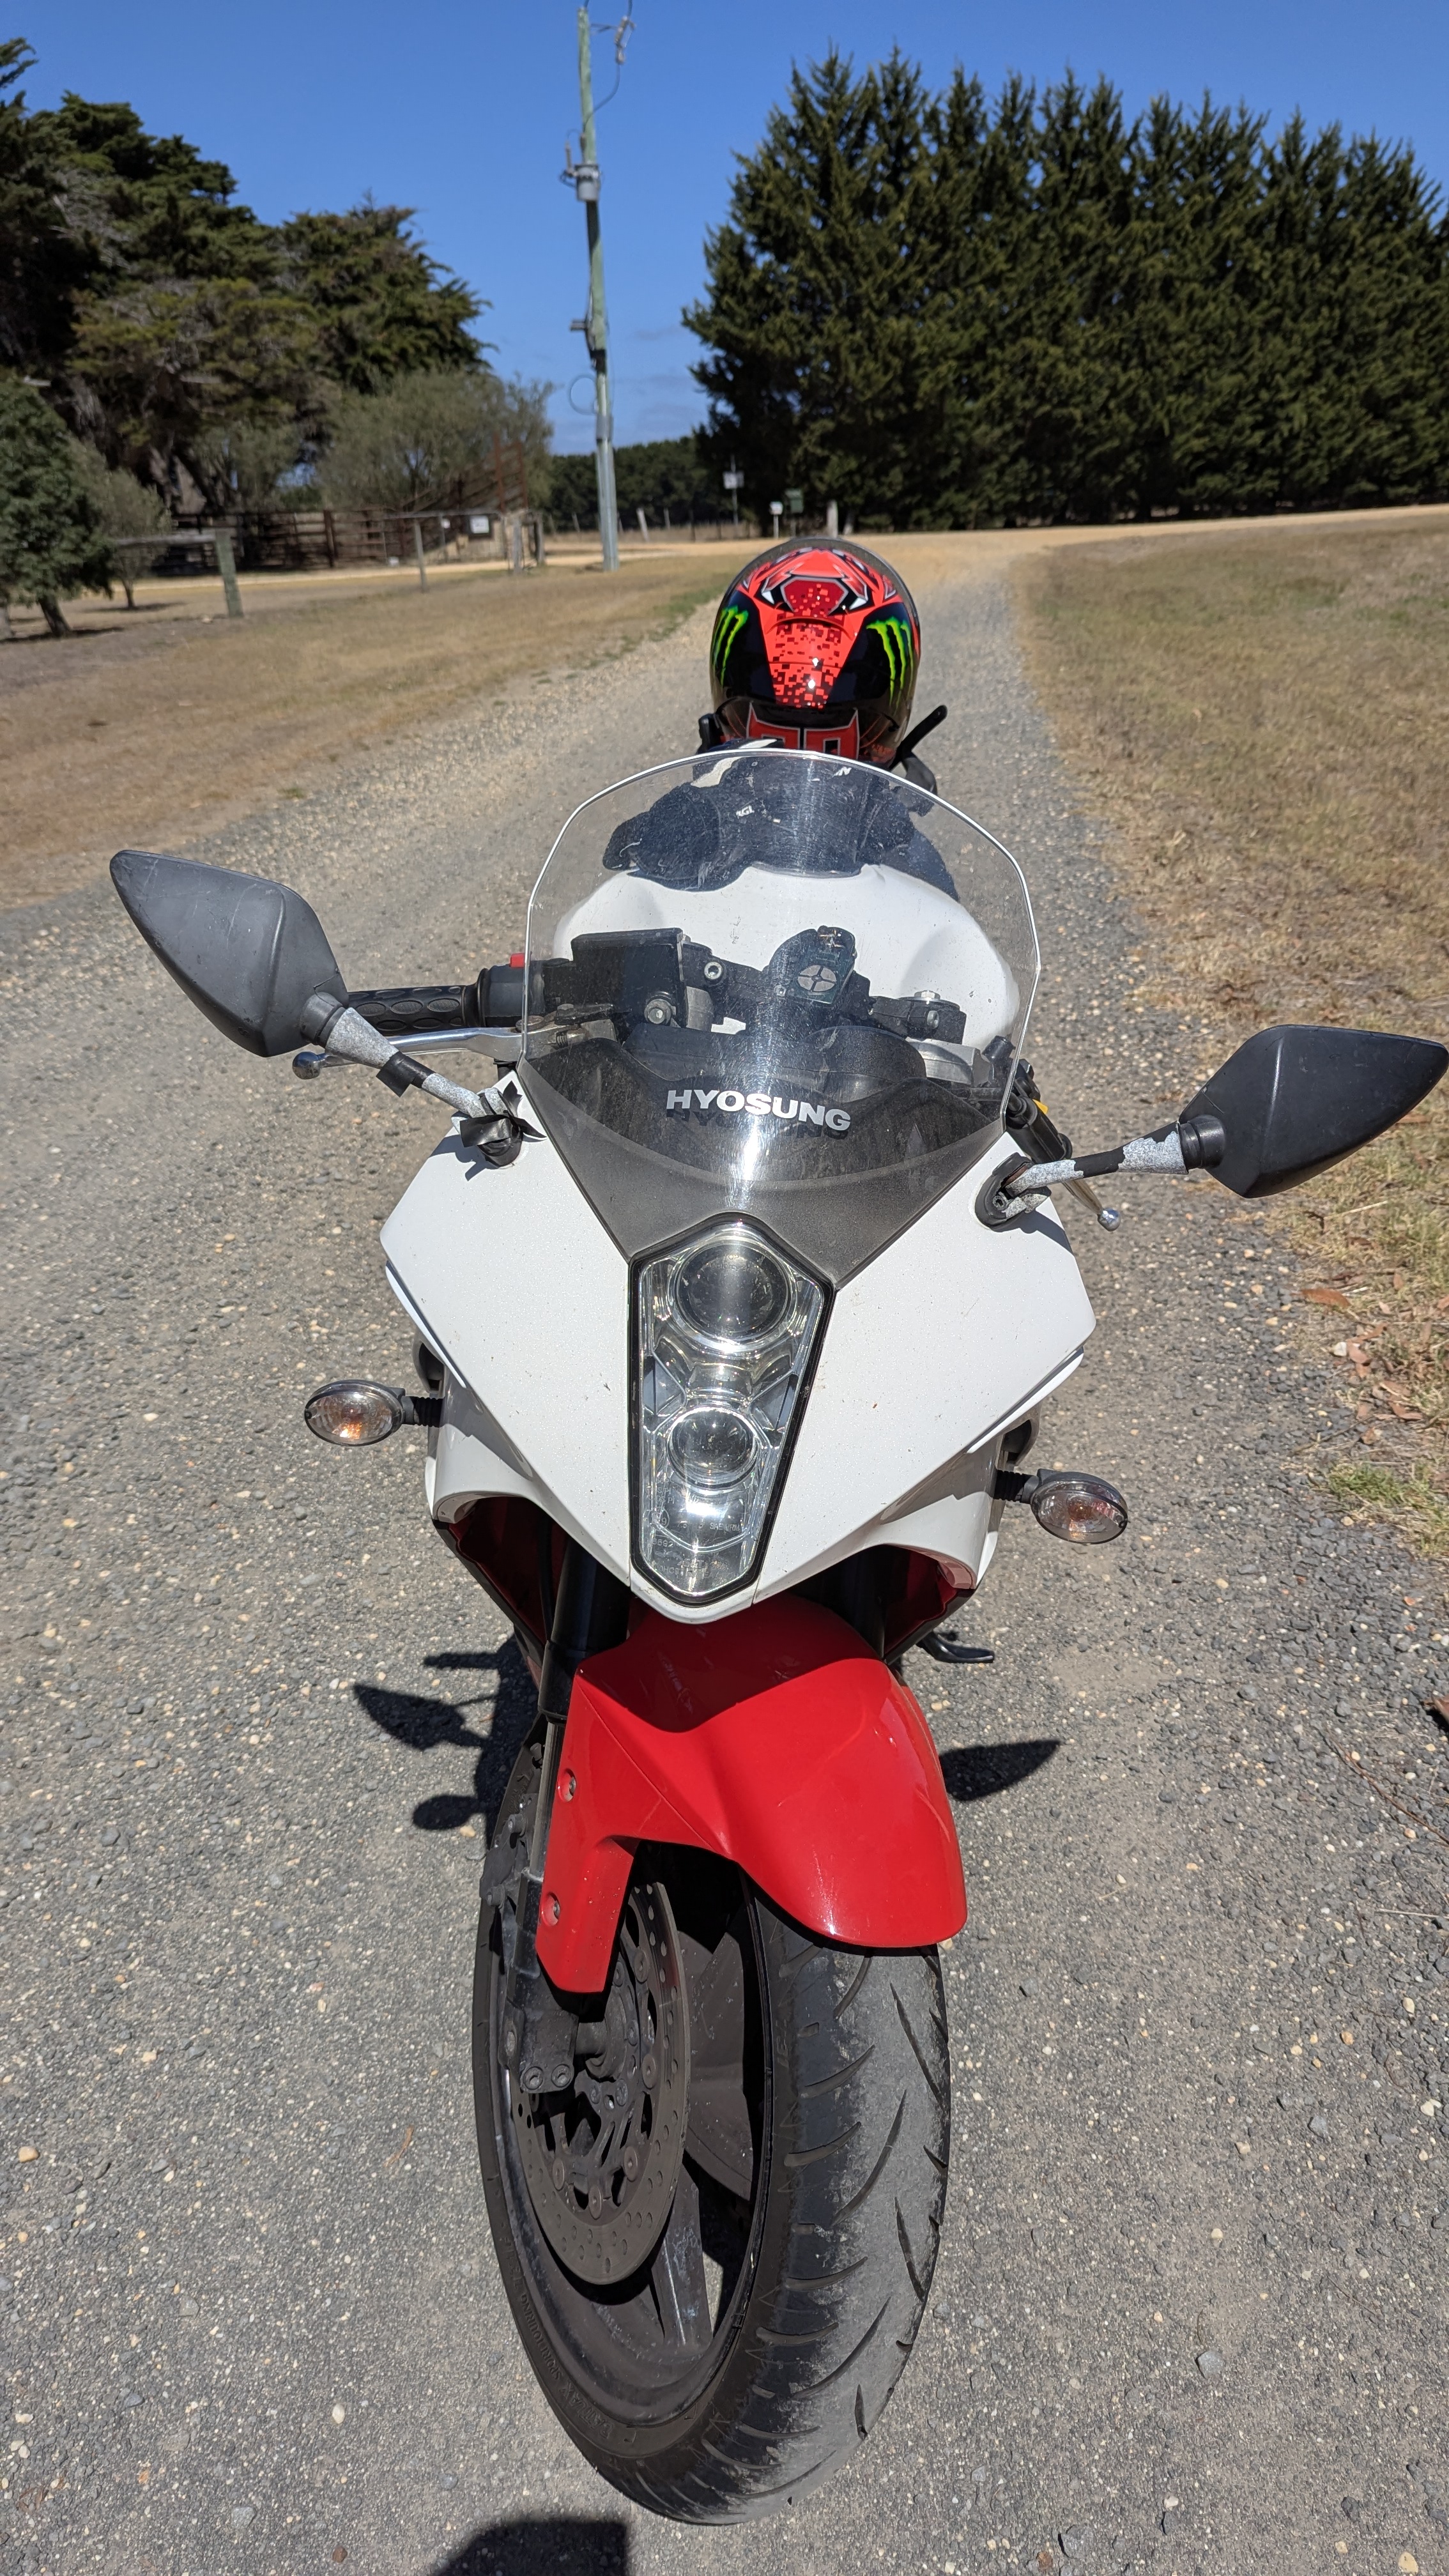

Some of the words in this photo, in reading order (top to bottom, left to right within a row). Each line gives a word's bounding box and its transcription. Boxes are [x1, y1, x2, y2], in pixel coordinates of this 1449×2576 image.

[666, 1089, 851, 1131] HYOSUNG
[520, 2293, 544, 2345] TOURING
[540, 2346, 562, 2380] SPORT
